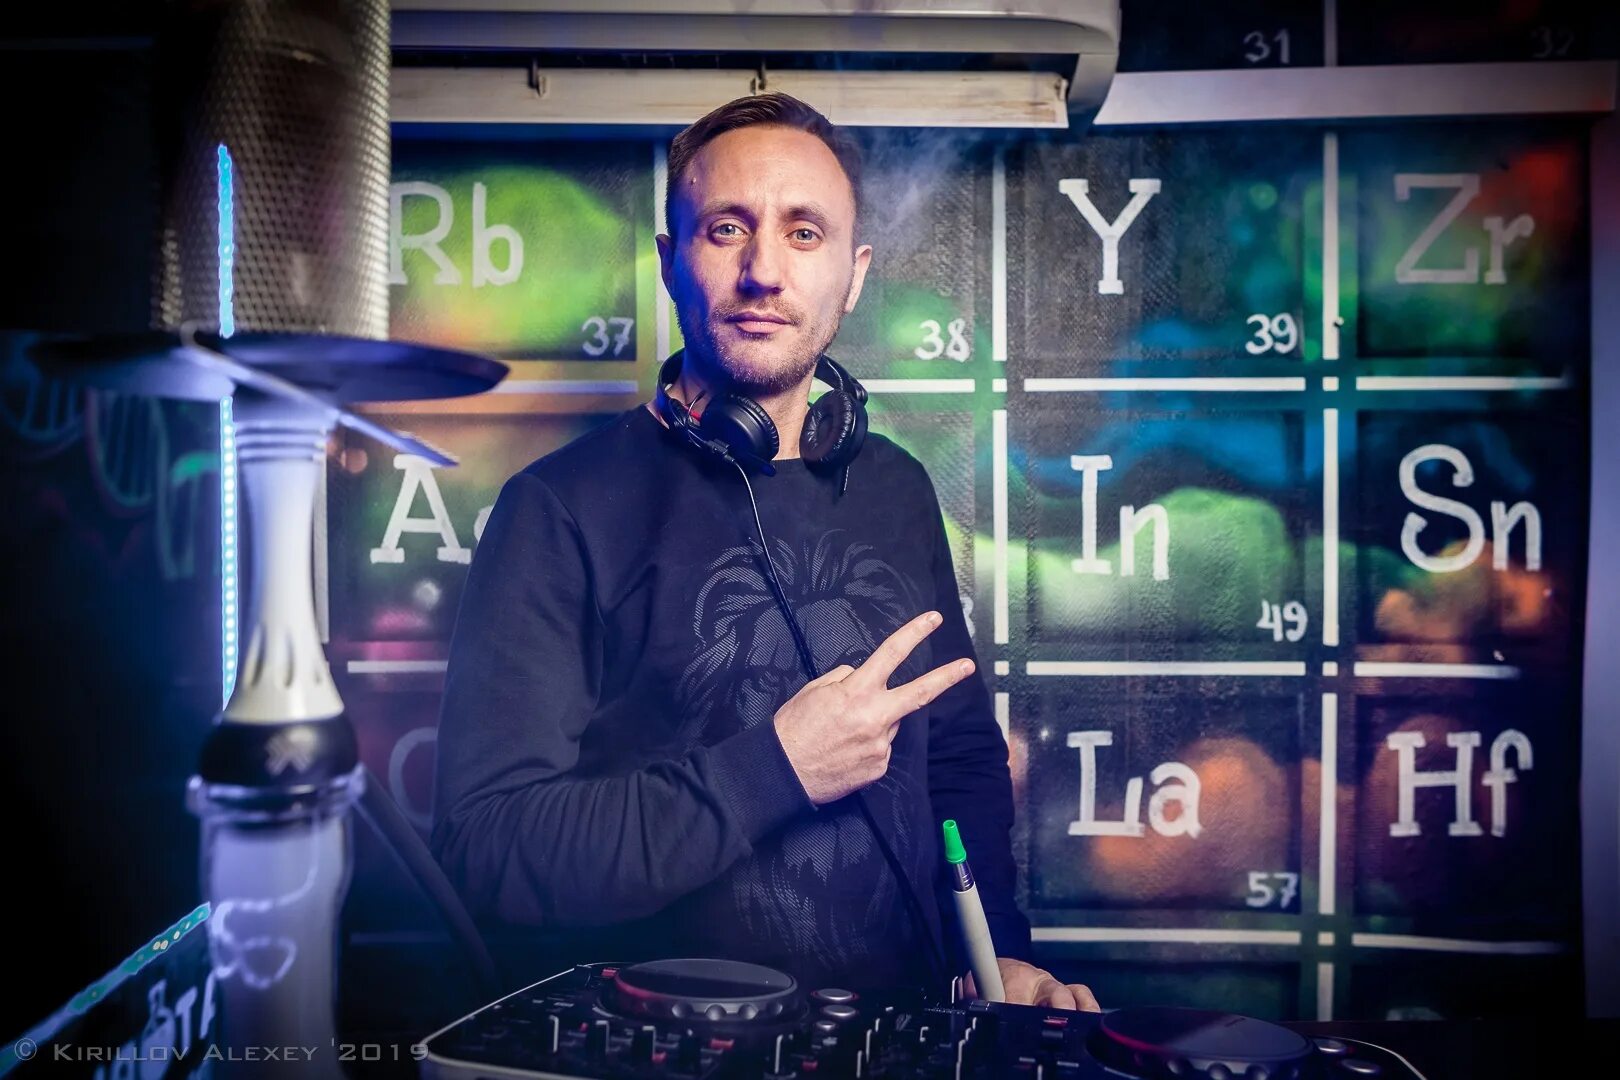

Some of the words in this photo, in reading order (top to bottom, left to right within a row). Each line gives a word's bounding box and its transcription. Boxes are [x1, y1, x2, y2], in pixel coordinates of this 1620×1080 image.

[1243, 28, 1291, 64] 31
[386, 180, 524, 288] Rb
[1059, 178, 1162, 294] Y
[1393, 173, 1535, 284] Zr
[581, 316, 634, 356] 37
[914, 318, 971, 362] 38
[1245, 312, 1299, 355] 39
[370, 453, 493, 565] A
[1070, 454, 1170, 581] In
[1399, 444, 1542, 572] Sn
[1256, 600, 1308, 642] 49
[1066, 730, 1202, 840] La
[1387, 728, 1533, 838] Hf
[1246, 872, 1299, 908] 57
